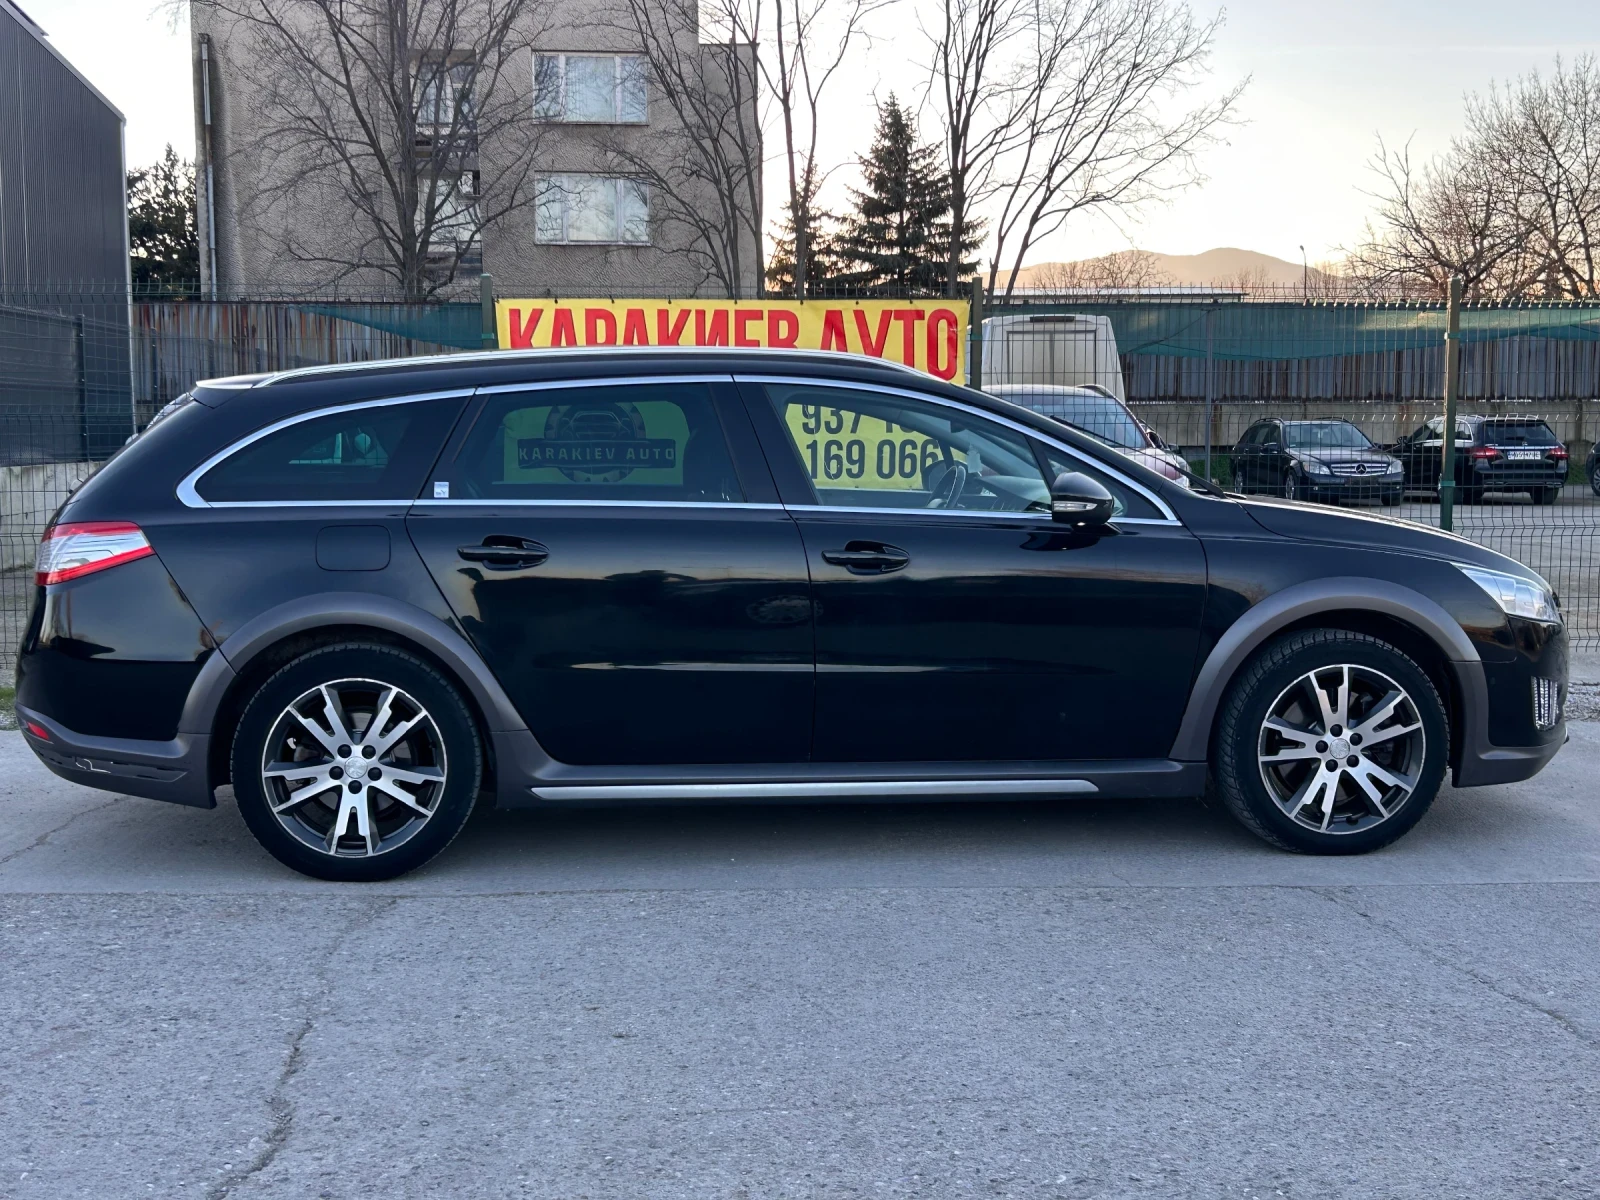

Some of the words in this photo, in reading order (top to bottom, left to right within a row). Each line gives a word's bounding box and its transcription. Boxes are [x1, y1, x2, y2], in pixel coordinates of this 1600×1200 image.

[519, 447, 615, 461] KARAKIEV
[626, 447, 674, 461] AUTO
[806, 439, 866, 480] 169
[876, 439, 939, 480] 066
